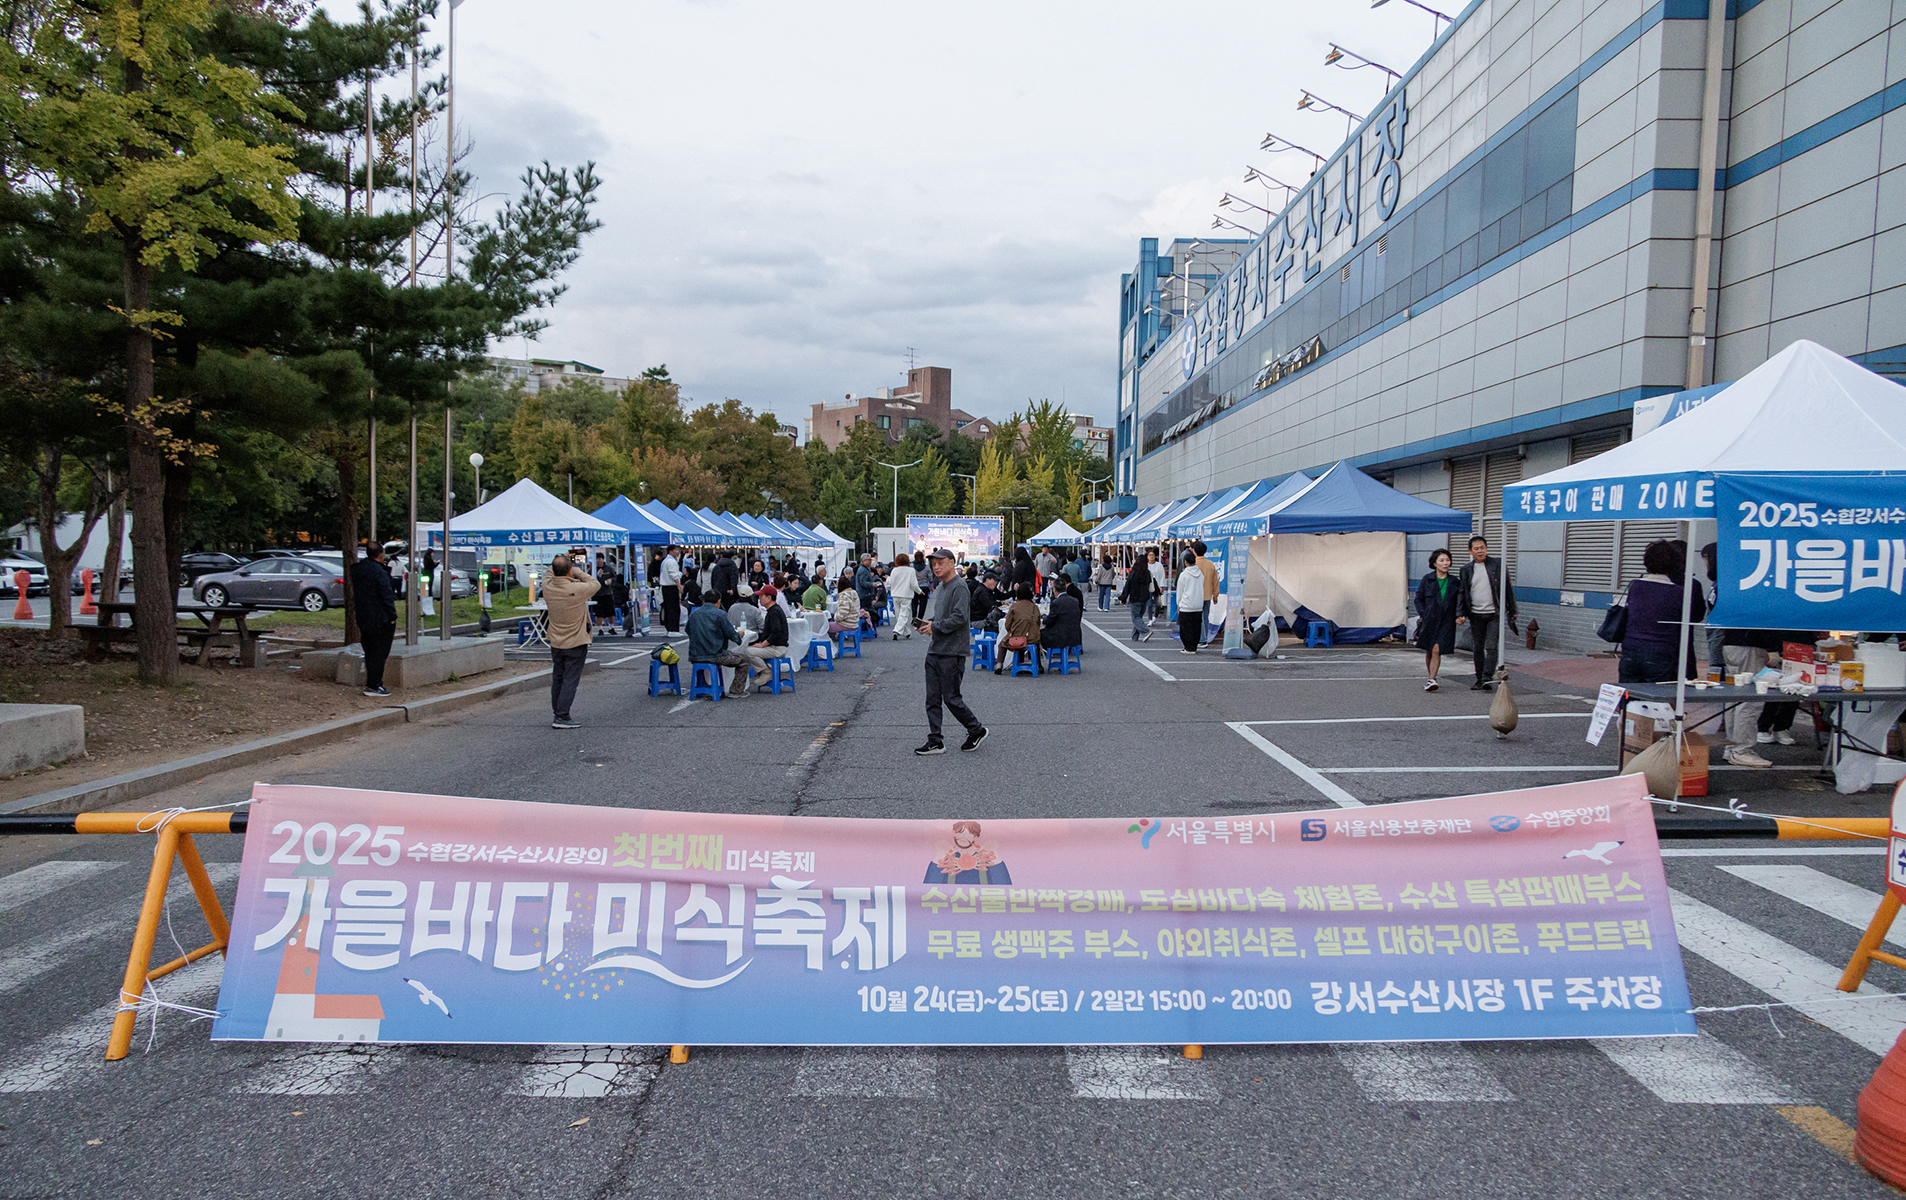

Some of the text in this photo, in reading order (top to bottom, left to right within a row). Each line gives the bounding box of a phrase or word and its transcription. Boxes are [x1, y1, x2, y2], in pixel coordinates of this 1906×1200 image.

[1200, 88, 1410, 367] 수협강서수산시장
[1591, 484, 1624, 512] 판매
[1638, 479, 1715, 509] ZONE
[1738, 501, 1819, 528] 2025
[1167, 819, 1276, 845] 서울특별시
[1333, 818, 1472, 838] 서울신용보증재단
[1525, 805, 1612, 829] 수협중앙회
[269, 821, 816, 873] 2025 수협강서수산시장의 첫번째 미식축제
[921, 872, 1645, 914] 수산물반짝경매, 도심바다속 체험존, 수산 특설판매부스
[254, 874, 907, 974] 가을바다 미식축제
[927, 919, 1653, 960] 무료 생맥주 부스, 야외취식존, 셀프 대하구이존, 푸드트럭
[857, 985, 907, 1013] 10월
[913, 985, 1068, 1013] 24(금)~25(토)
[1090, 990, 1144, 1011] 2일간
[1149, 989, 1206, 1011] 15:00
[1231, 988, 1292, 1011] 20:00
[1310, 975, 1663, 1015] 강서수산시장 1F 주차장
